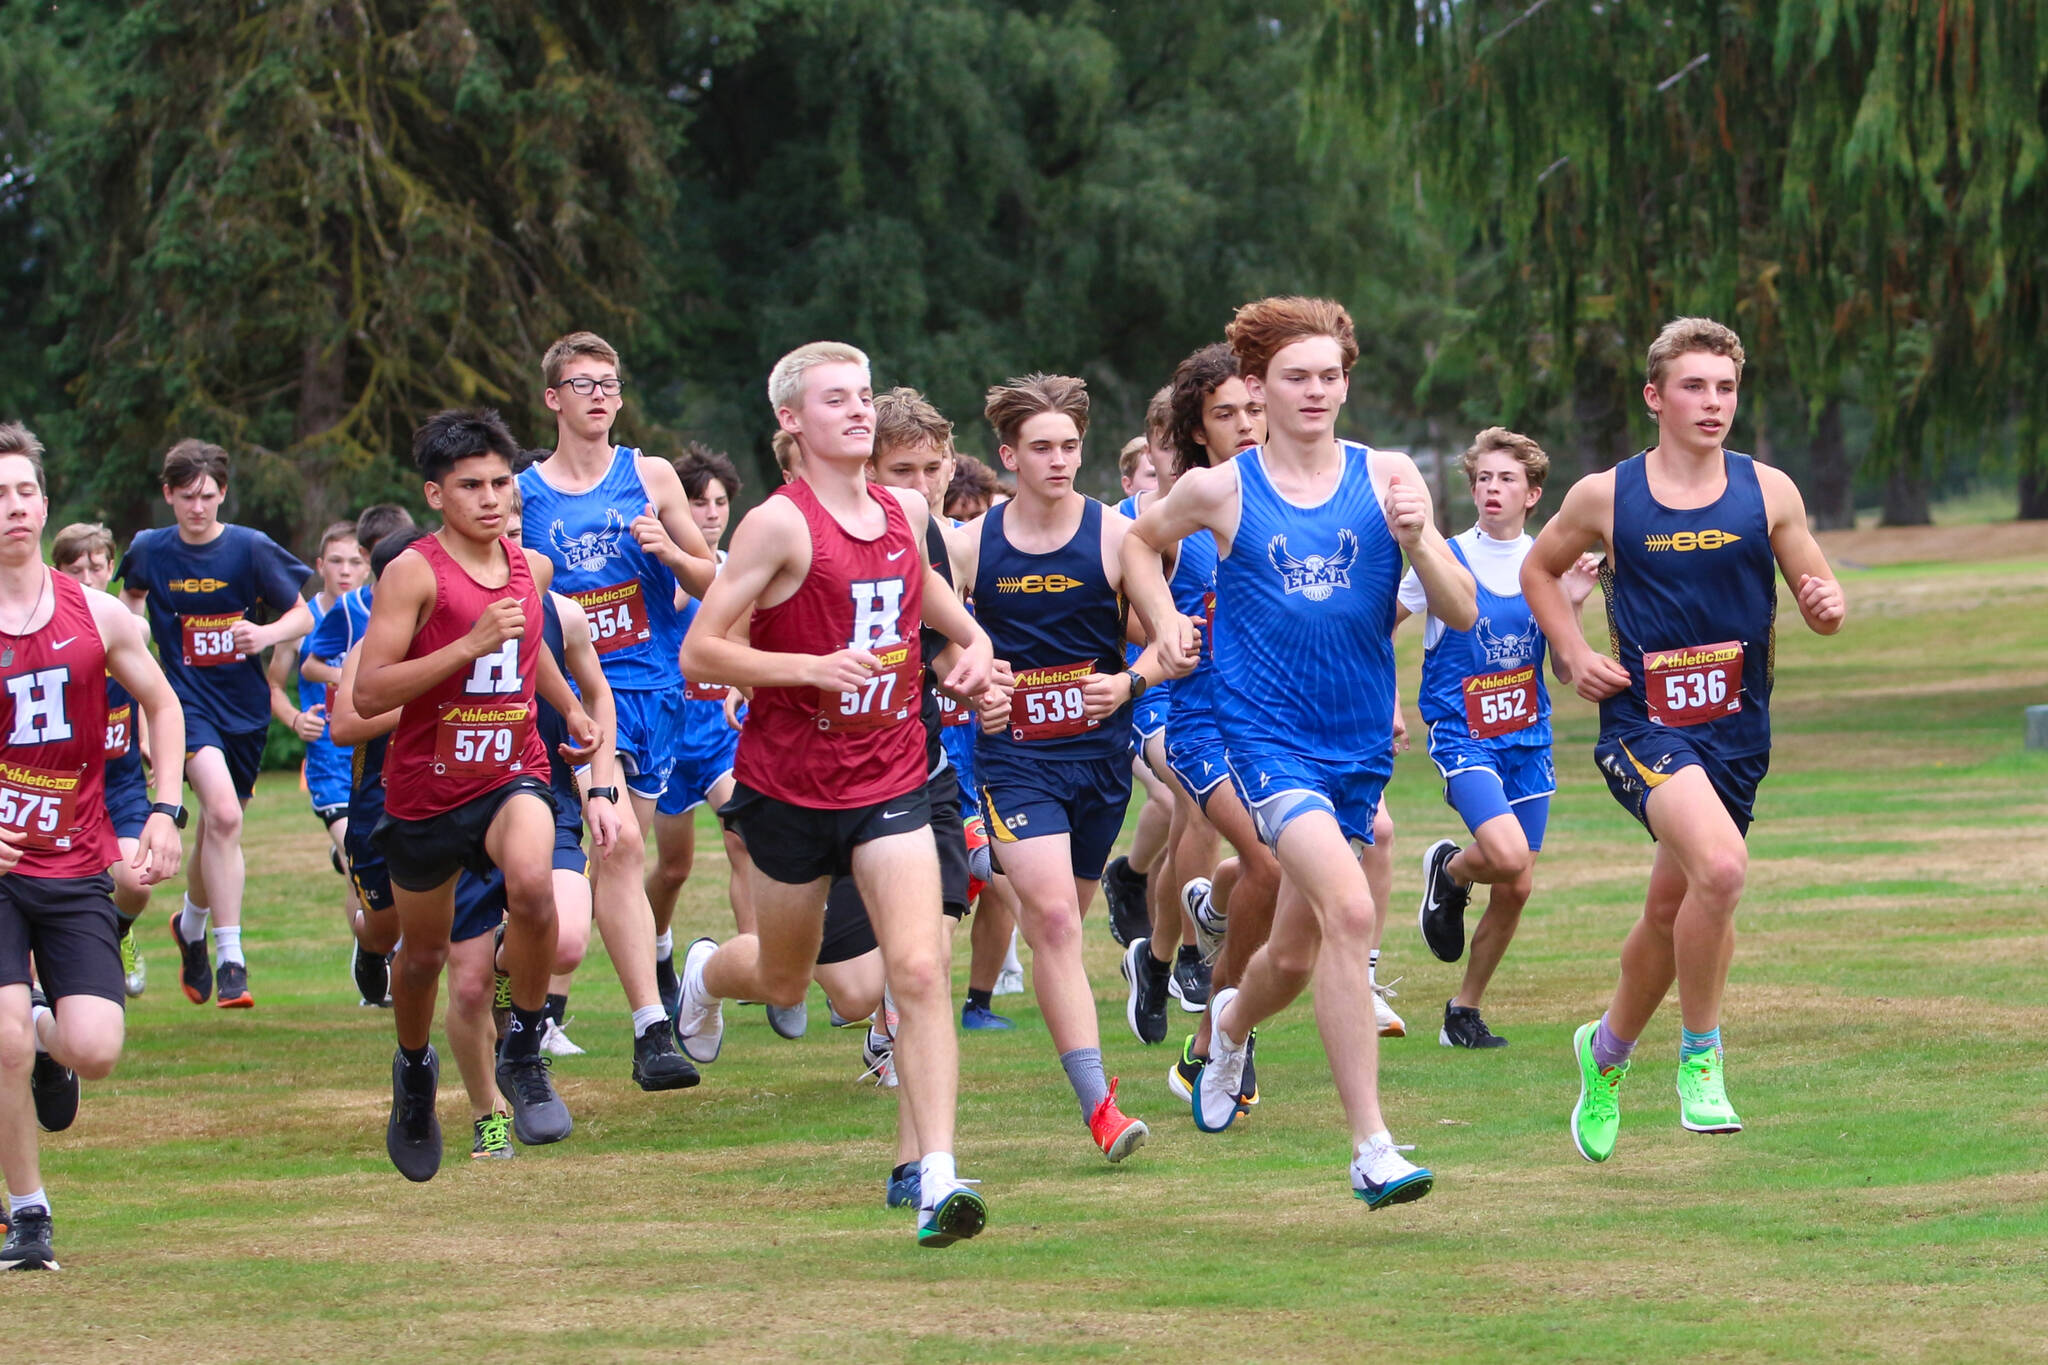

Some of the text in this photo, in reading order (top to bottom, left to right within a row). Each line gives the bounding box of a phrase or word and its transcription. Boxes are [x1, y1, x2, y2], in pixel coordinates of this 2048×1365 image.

[568, 543, 618, 564] ELMA
[1288, 568, 1347, 588] ELMA
[586, 604, 633, 642] 554
[848, 579, 904, 650] H
[194, 631, 234, 656] 538
[1490, 647, 1530, 660] ELMA
[6, 667, 71, 745] H
[840, 672, 897, 715] 577
[1025, 688, 1084, 724] 539
[1481, 688, 1527, 724] 552
[1665, 669, 1727, 709] 536
[454, 728, 513, 763] 579
[0, 787, 62, 832] 575
[1005, 813, 1028, 829] CC
